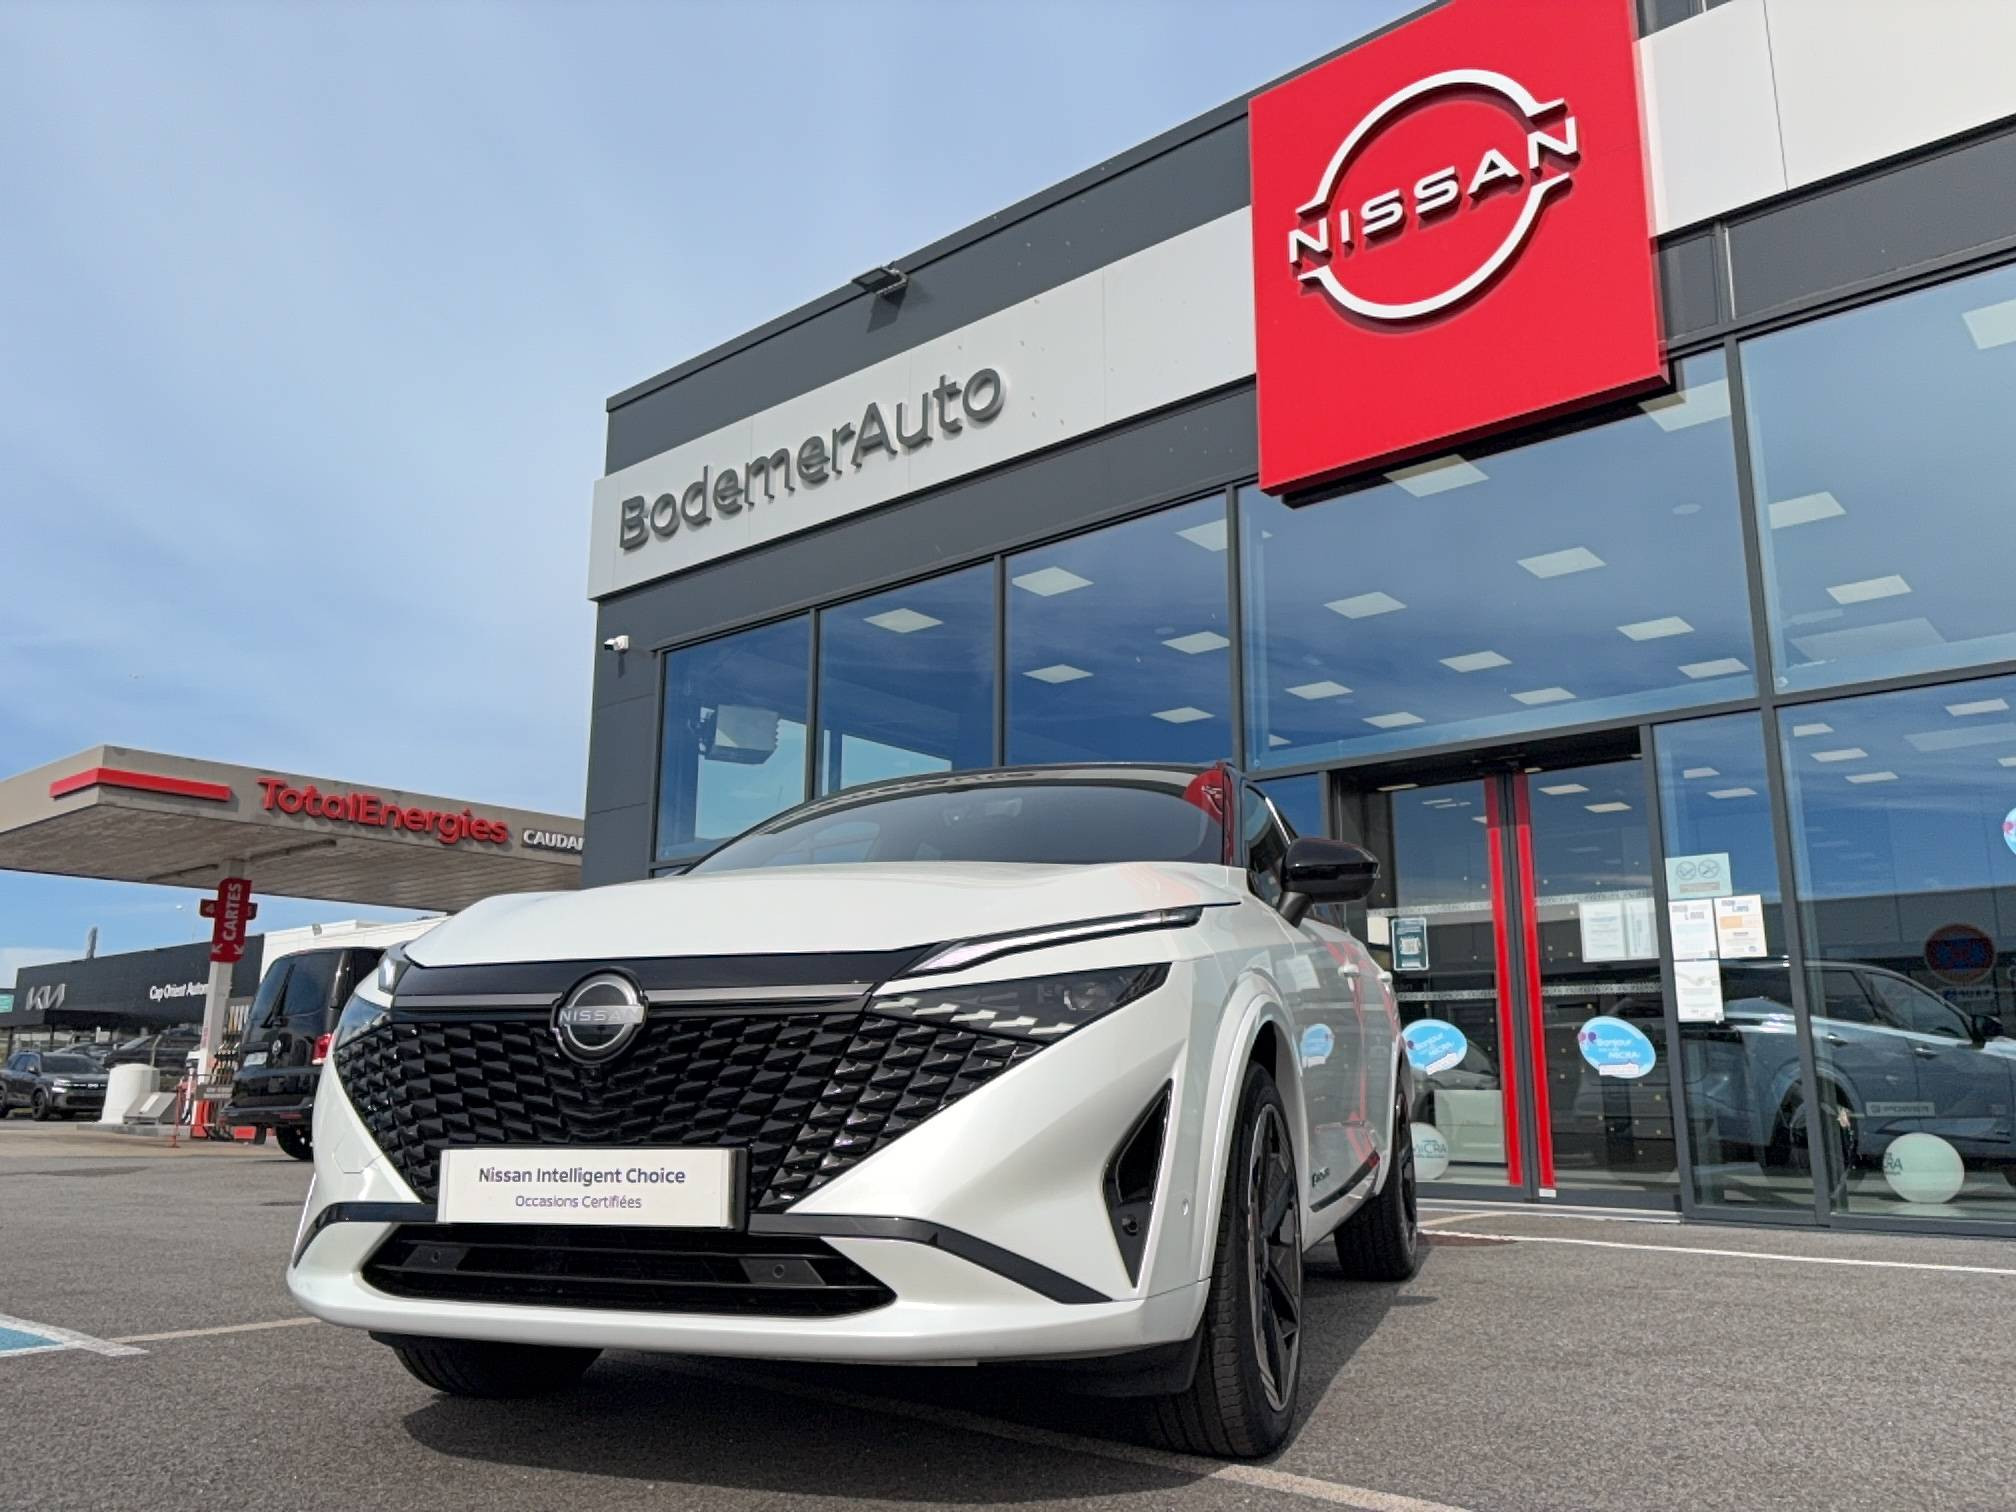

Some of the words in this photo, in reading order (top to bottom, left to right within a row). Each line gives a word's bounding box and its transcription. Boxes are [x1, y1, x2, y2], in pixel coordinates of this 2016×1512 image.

[1288, 116, 1580, 265] NISSAN
[619, 368, 1006, 551] BodemerAuto
[256, 775, 509, 844] TotalEnergies
[223, 884, 242, 941] CARTES
[559, 1006, 641, 1023] NISSAN
[479, 1167, 532, 1183] Nissan
[536, 1167, 622, 1186] Intelligent
[625, 1168, 686, 1184] Choice
[515, 1195, 579, 1208] Occasions
[581, 1195, 642, 1209] Certifiées
